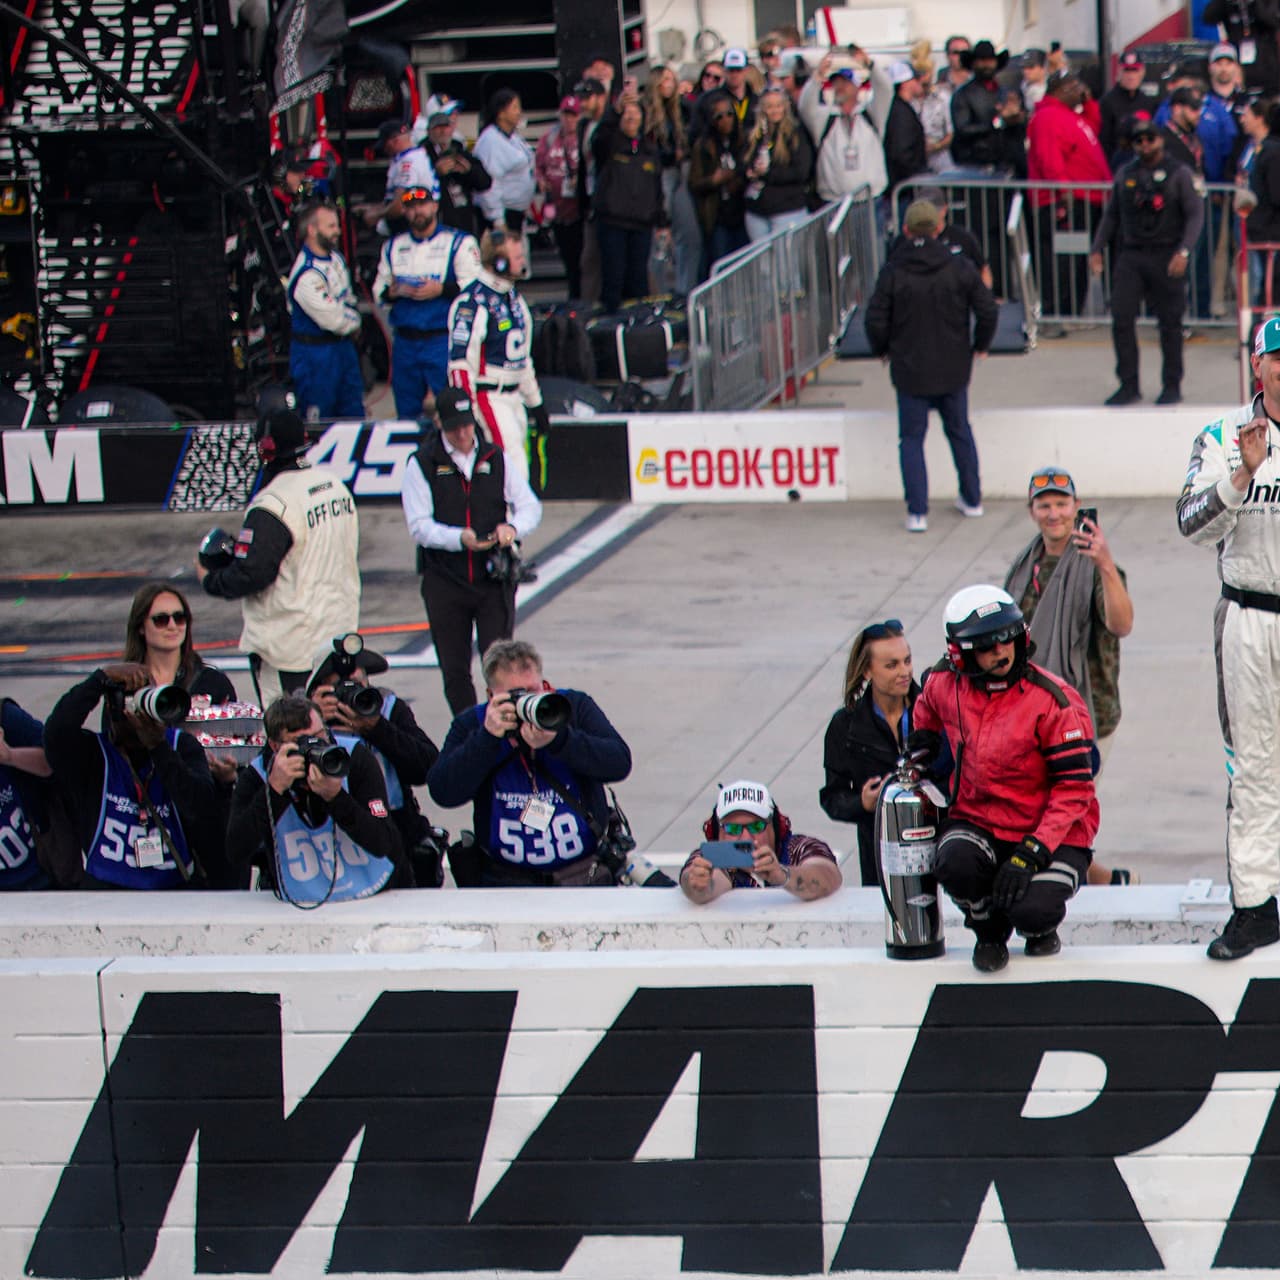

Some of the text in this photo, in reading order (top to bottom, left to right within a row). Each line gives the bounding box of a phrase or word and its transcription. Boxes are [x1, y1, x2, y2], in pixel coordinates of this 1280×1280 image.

[304, 421, 421, 496] 45
[664, 447, 840, 489] COOK OUT
[723, 787, 765, 806] PAPERCLIP
